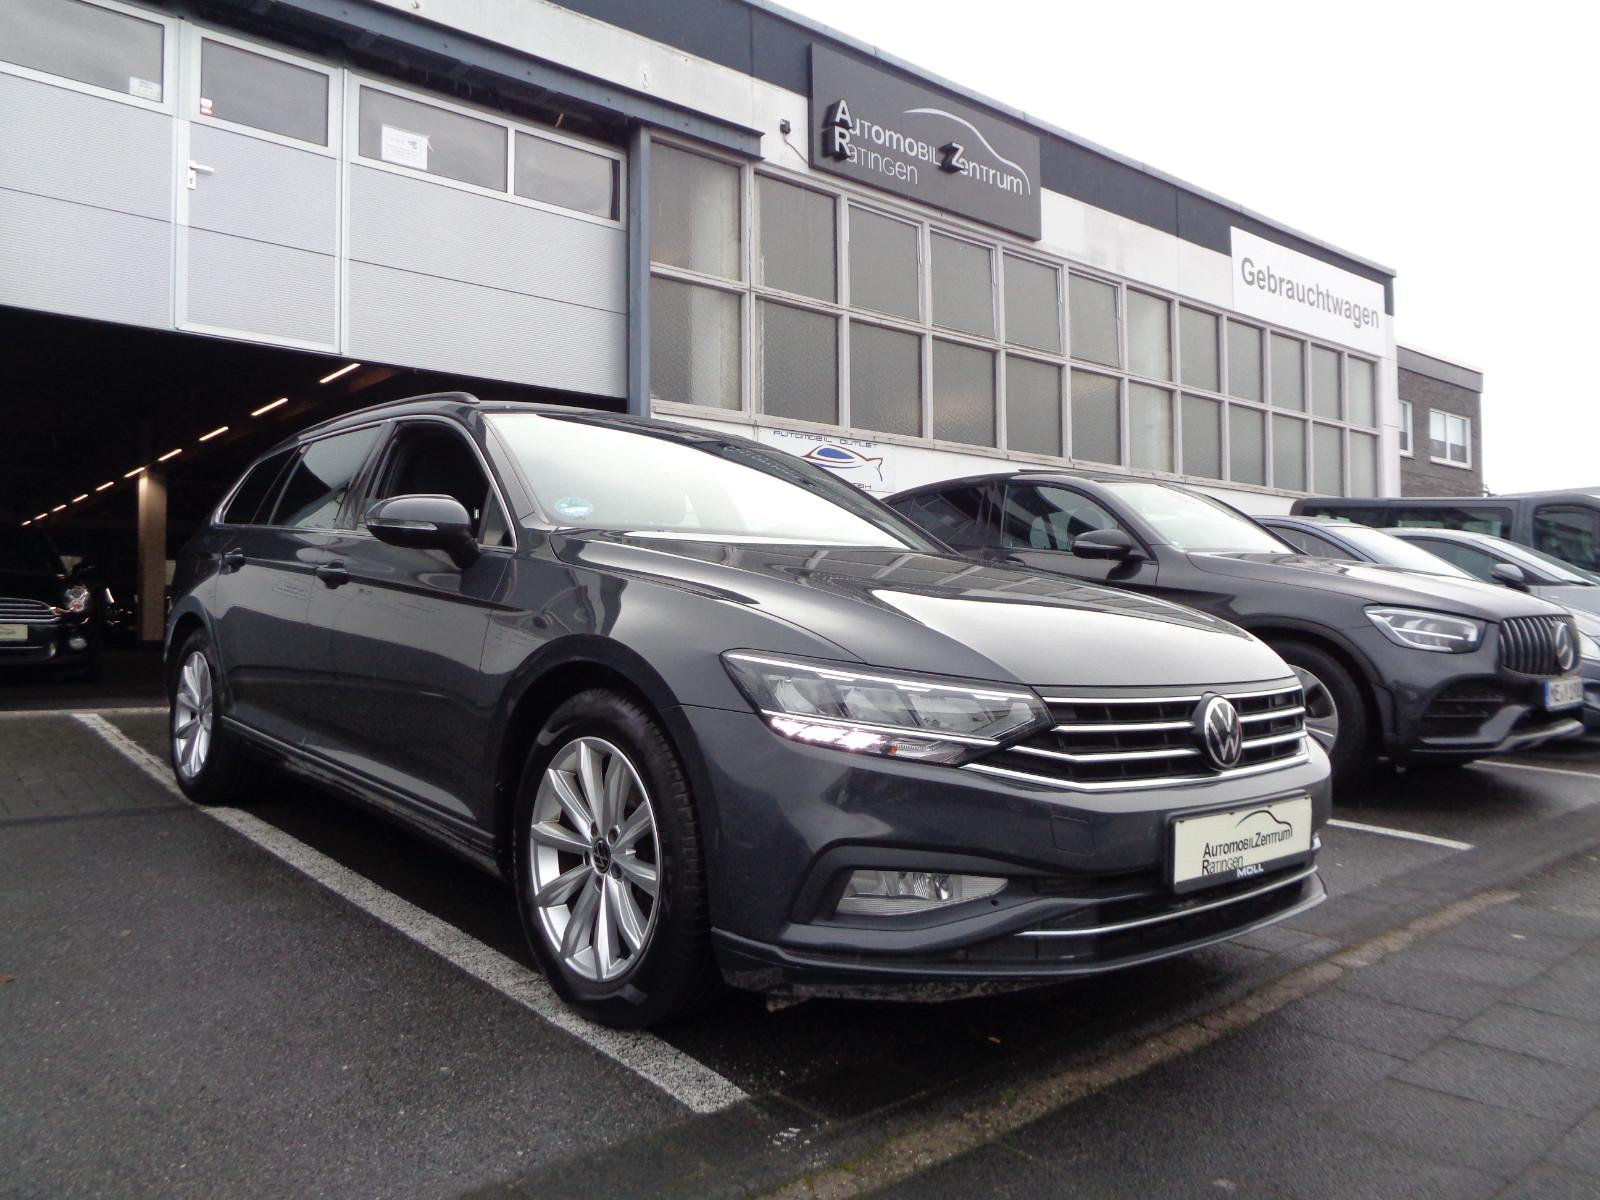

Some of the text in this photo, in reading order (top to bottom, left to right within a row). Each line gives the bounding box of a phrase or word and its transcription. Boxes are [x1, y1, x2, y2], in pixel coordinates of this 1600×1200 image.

[1241, 257, 1380, 329] Gebrauchtwagen
[773, 430, 879, 449] AUTOMOBIL OUTLET
[1201, 854, 1244, 876] Ratingen
[1236, 863, 1265, 879] MOLL
